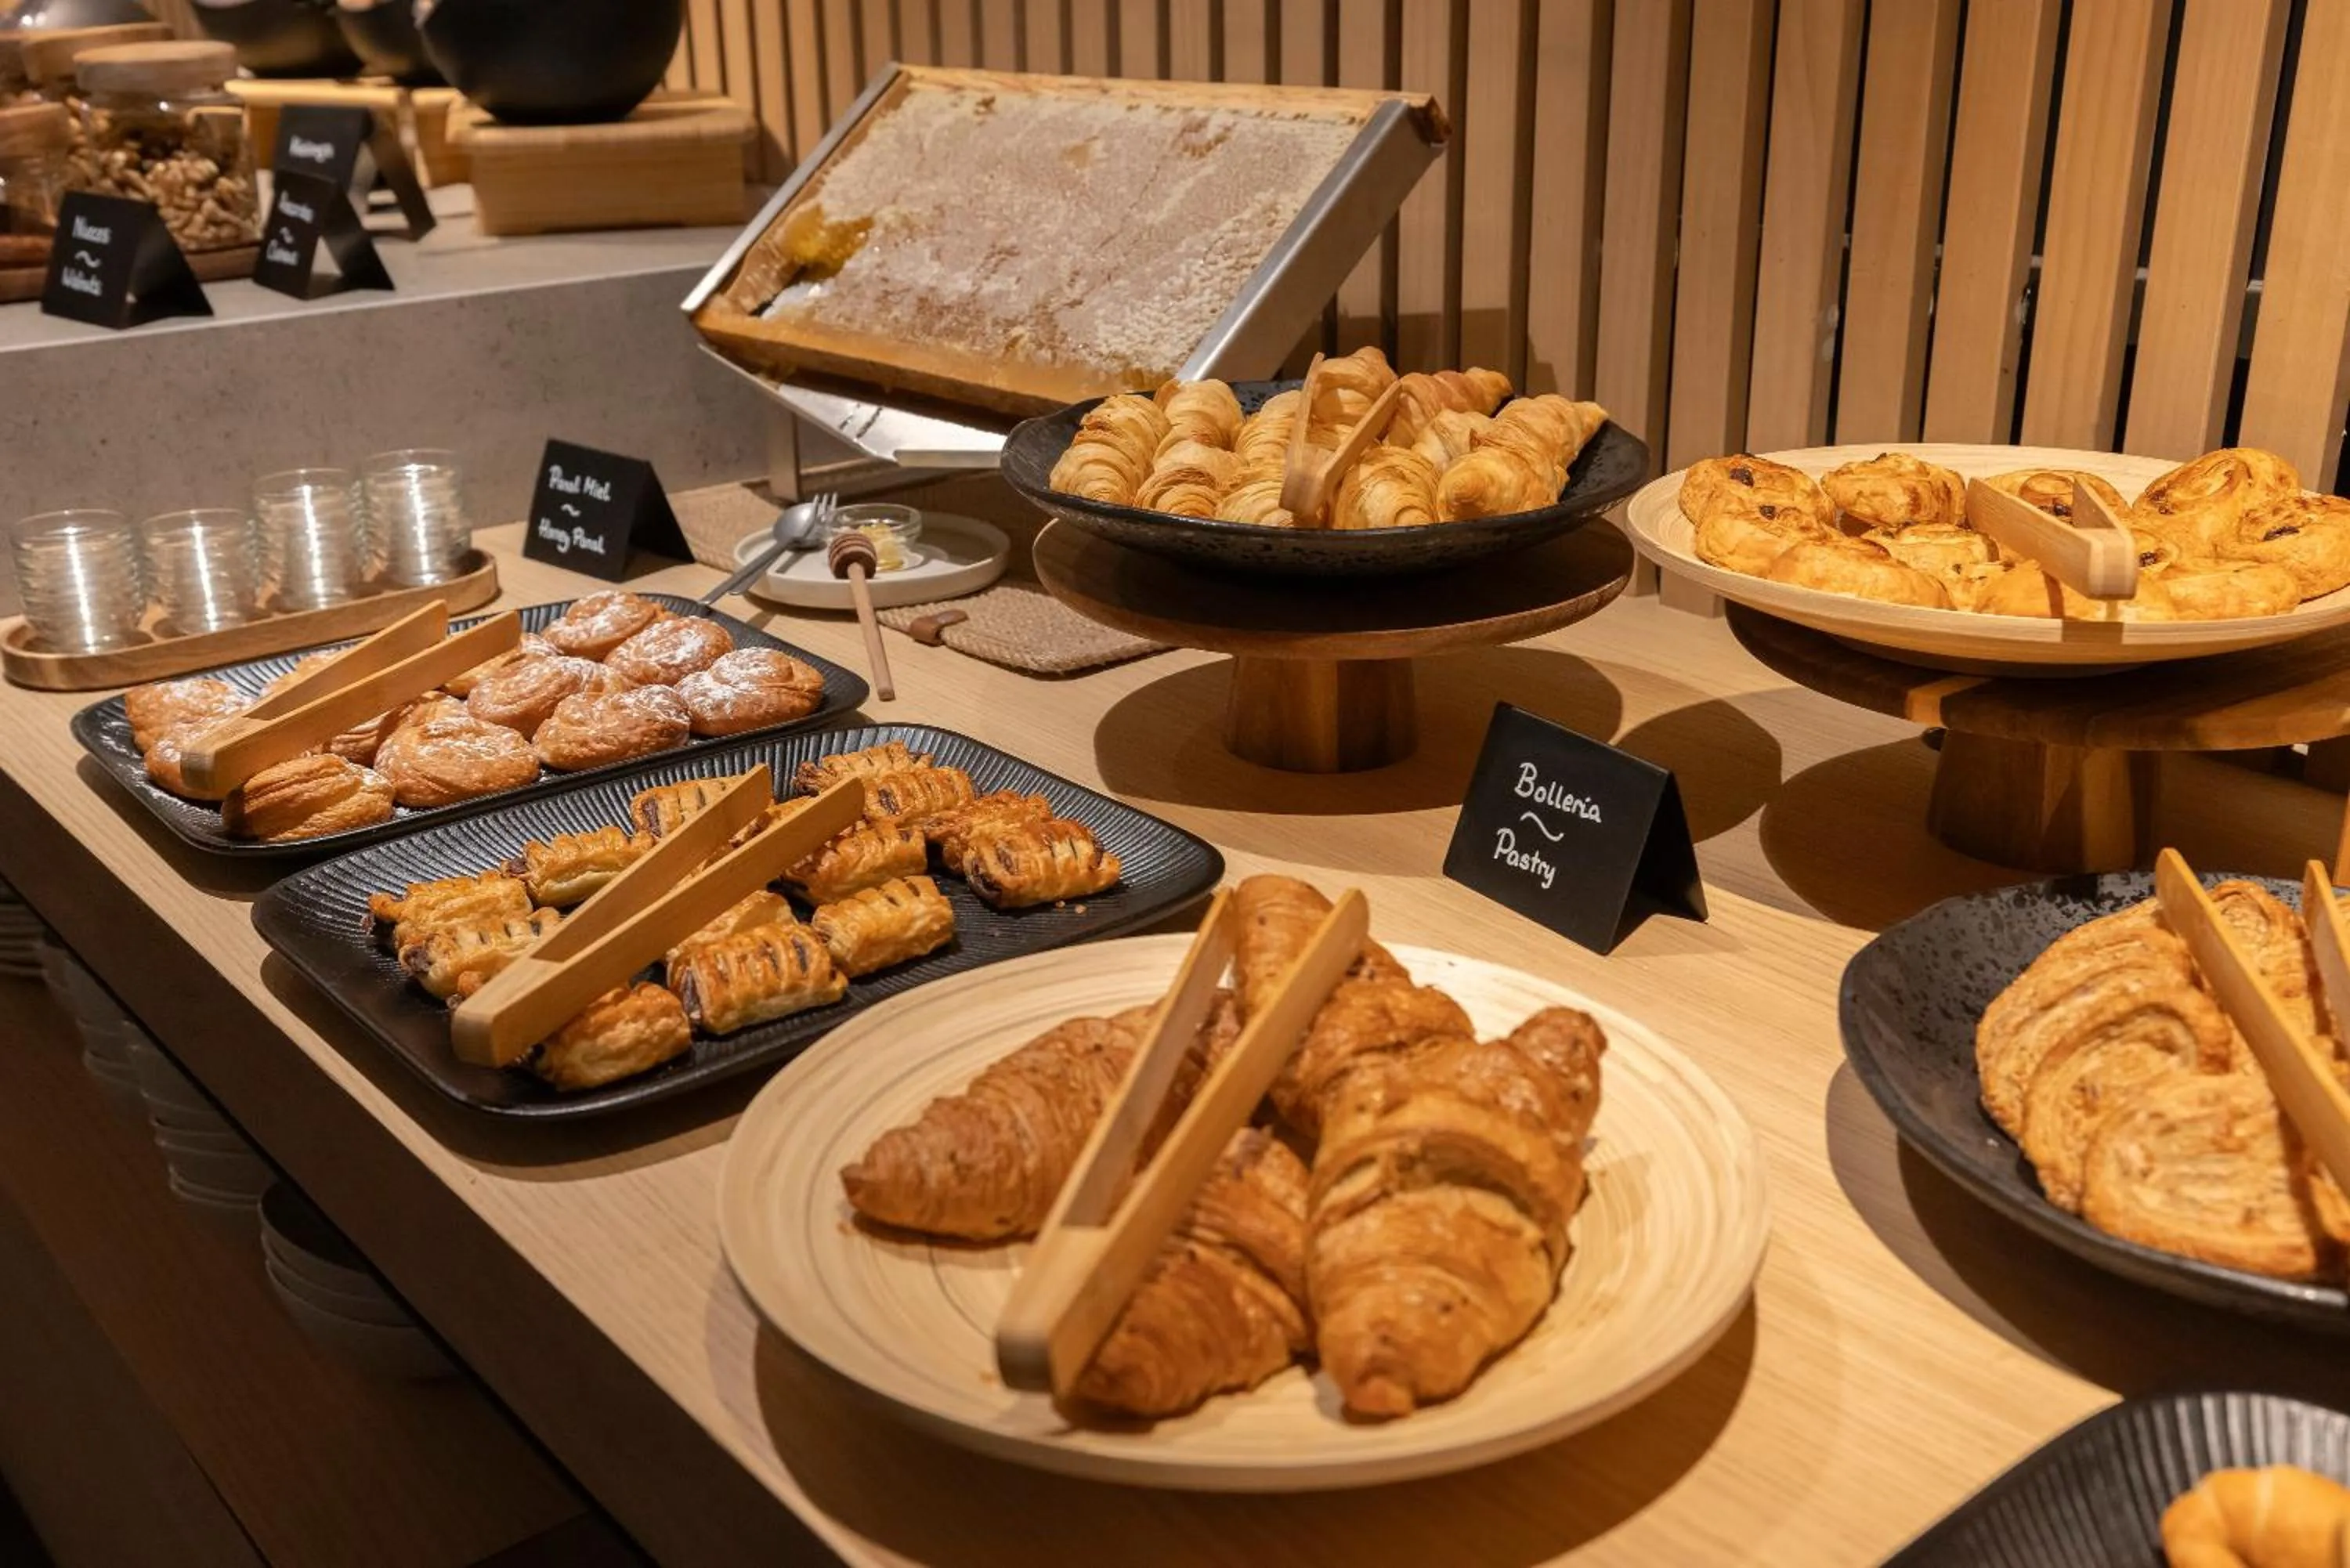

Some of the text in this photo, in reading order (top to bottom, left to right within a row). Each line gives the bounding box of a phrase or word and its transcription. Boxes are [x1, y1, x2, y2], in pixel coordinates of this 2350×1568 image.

[549, 464, 611, 501] Panal Miel
[538, 518, 606, 555] Honey Panal
[1494, 828, 1556, 889] Pastry
